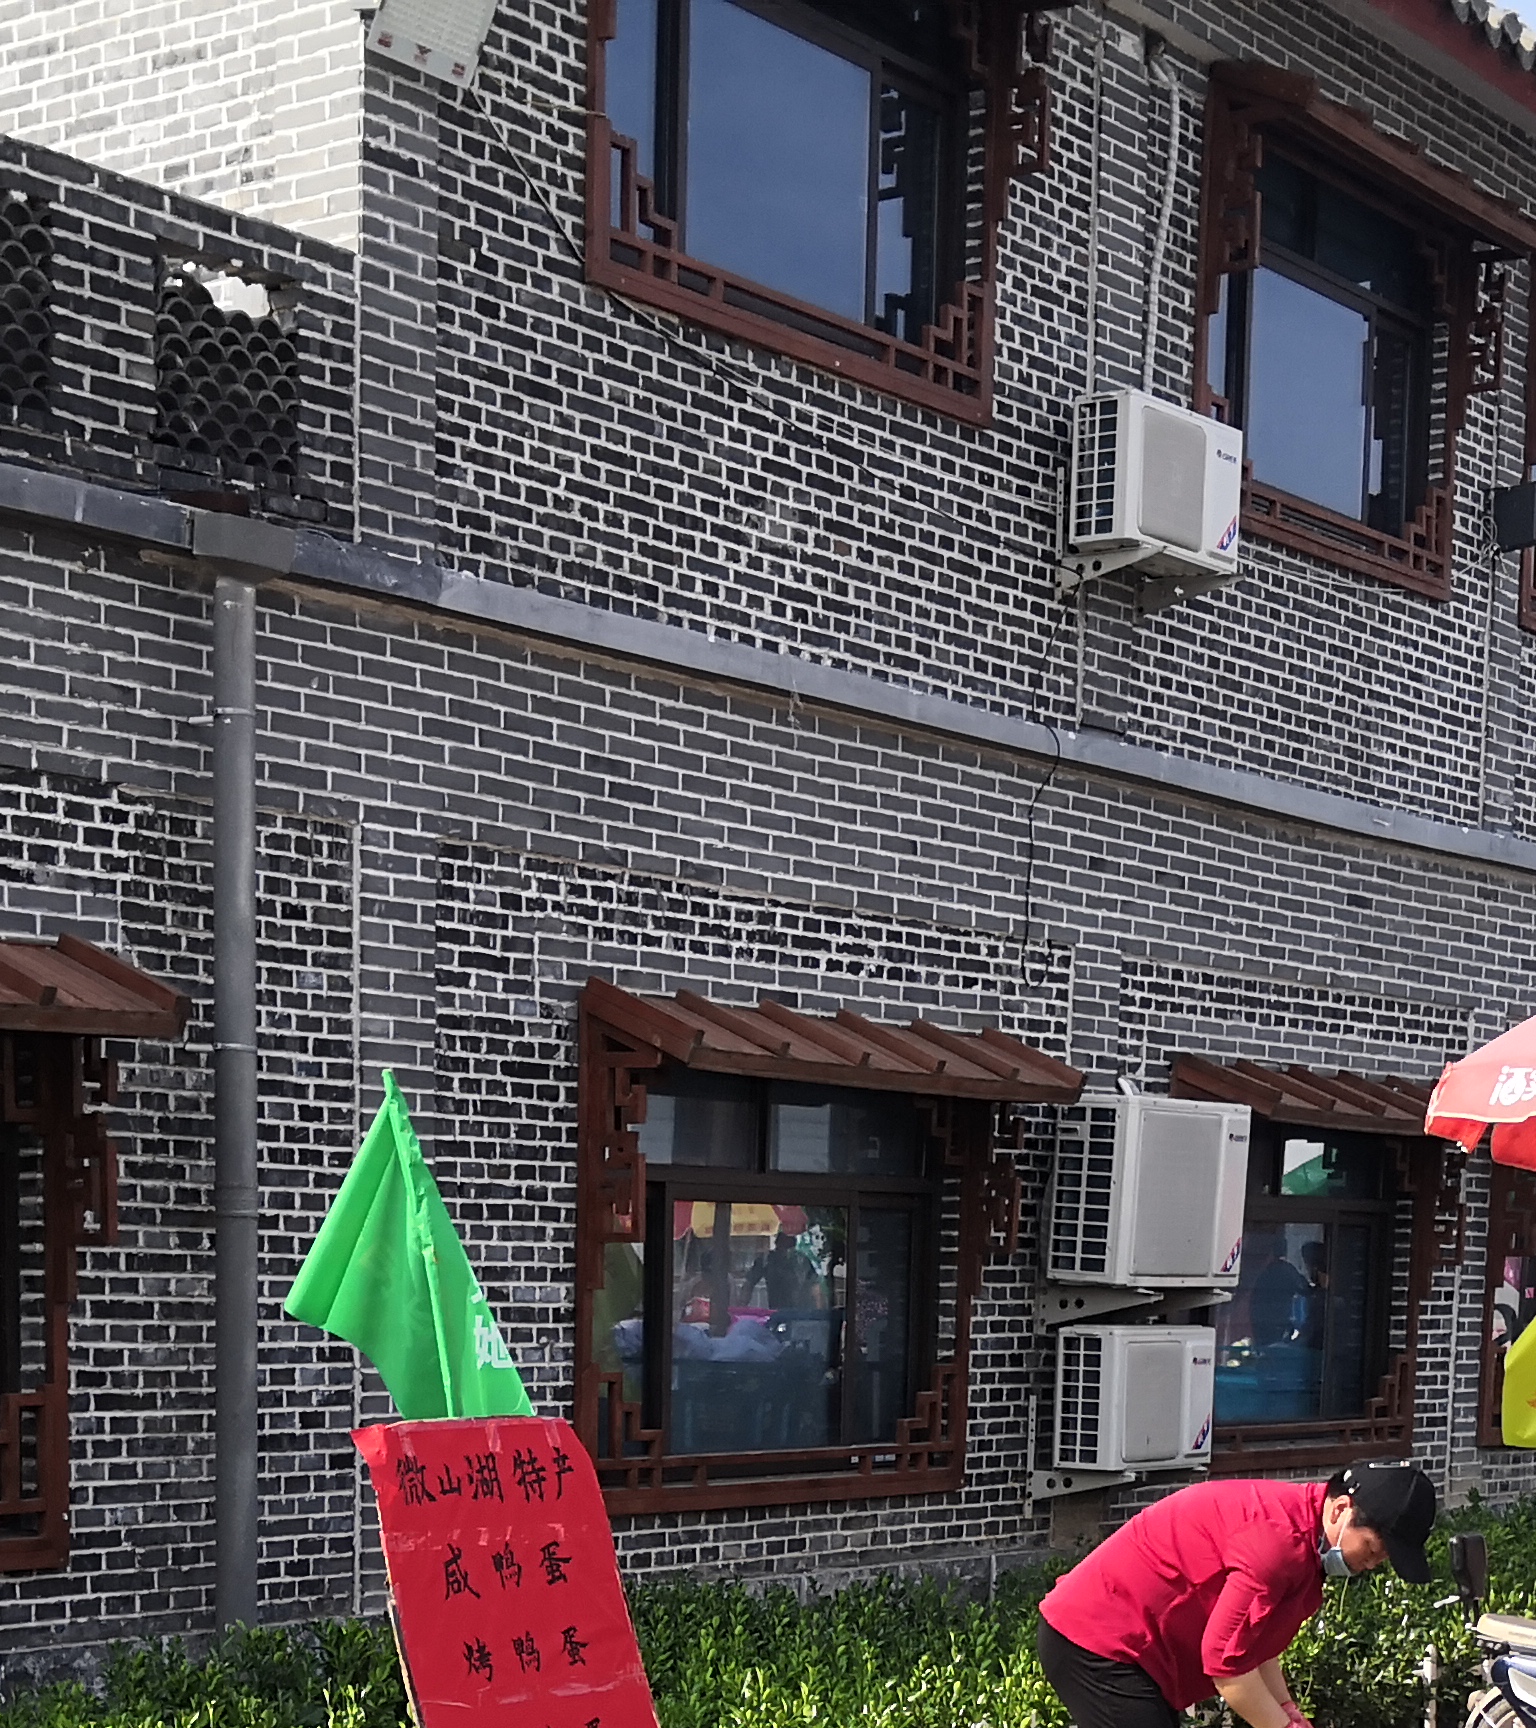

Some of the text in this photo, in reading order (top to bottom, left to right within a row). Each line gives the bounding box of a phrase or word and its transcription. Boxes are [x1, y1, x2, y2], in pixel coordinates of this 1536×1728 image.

[395, 1446, 575, 1507] 微山湖特产
[443, 1540, 573, 1601] 咸鸭蛋
[463, 1625, 589, 1684] 烤鸭蛋
